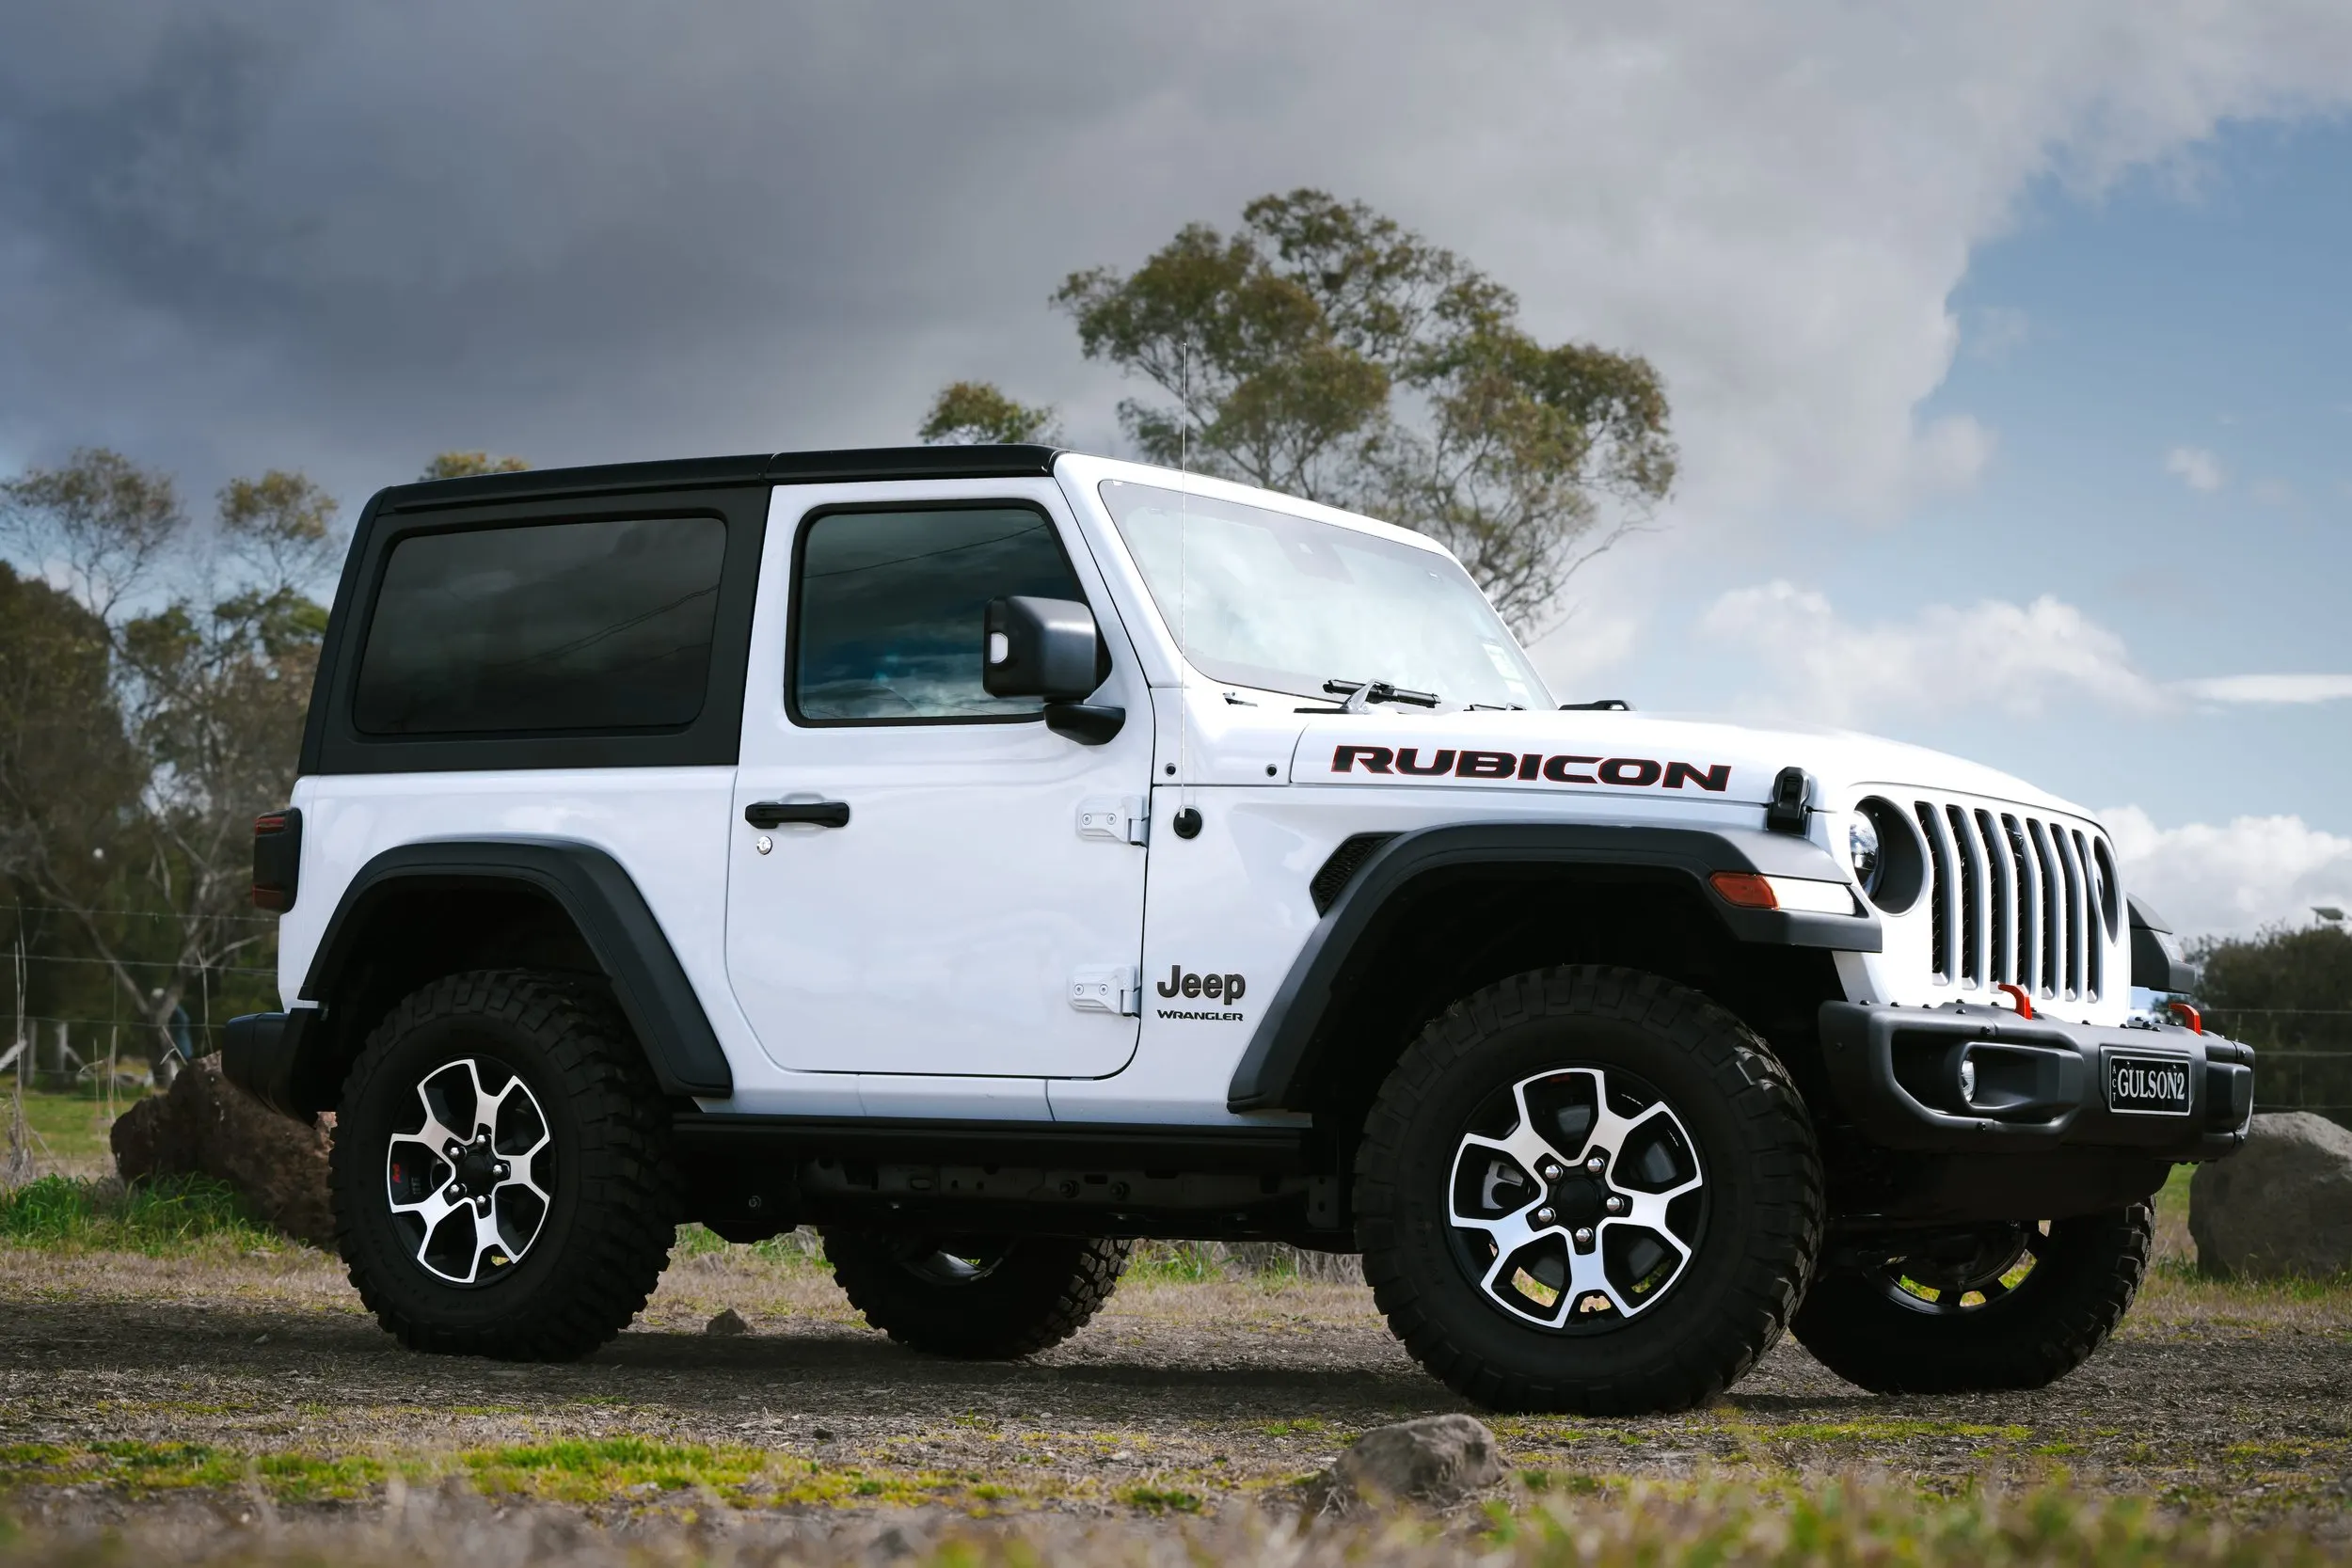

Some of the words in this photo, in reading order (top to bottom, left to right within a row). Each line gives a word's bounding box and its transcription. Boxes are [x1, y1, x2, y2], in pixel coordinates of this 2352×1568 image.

[1329, 744, 1732, 792] RUBICON
[1157, 964, 1246, 1006] Jeep
[1156, 1009, 1244, 1022] WRANGLER
[2117, 1068, 2185, 1100] GULSON2
